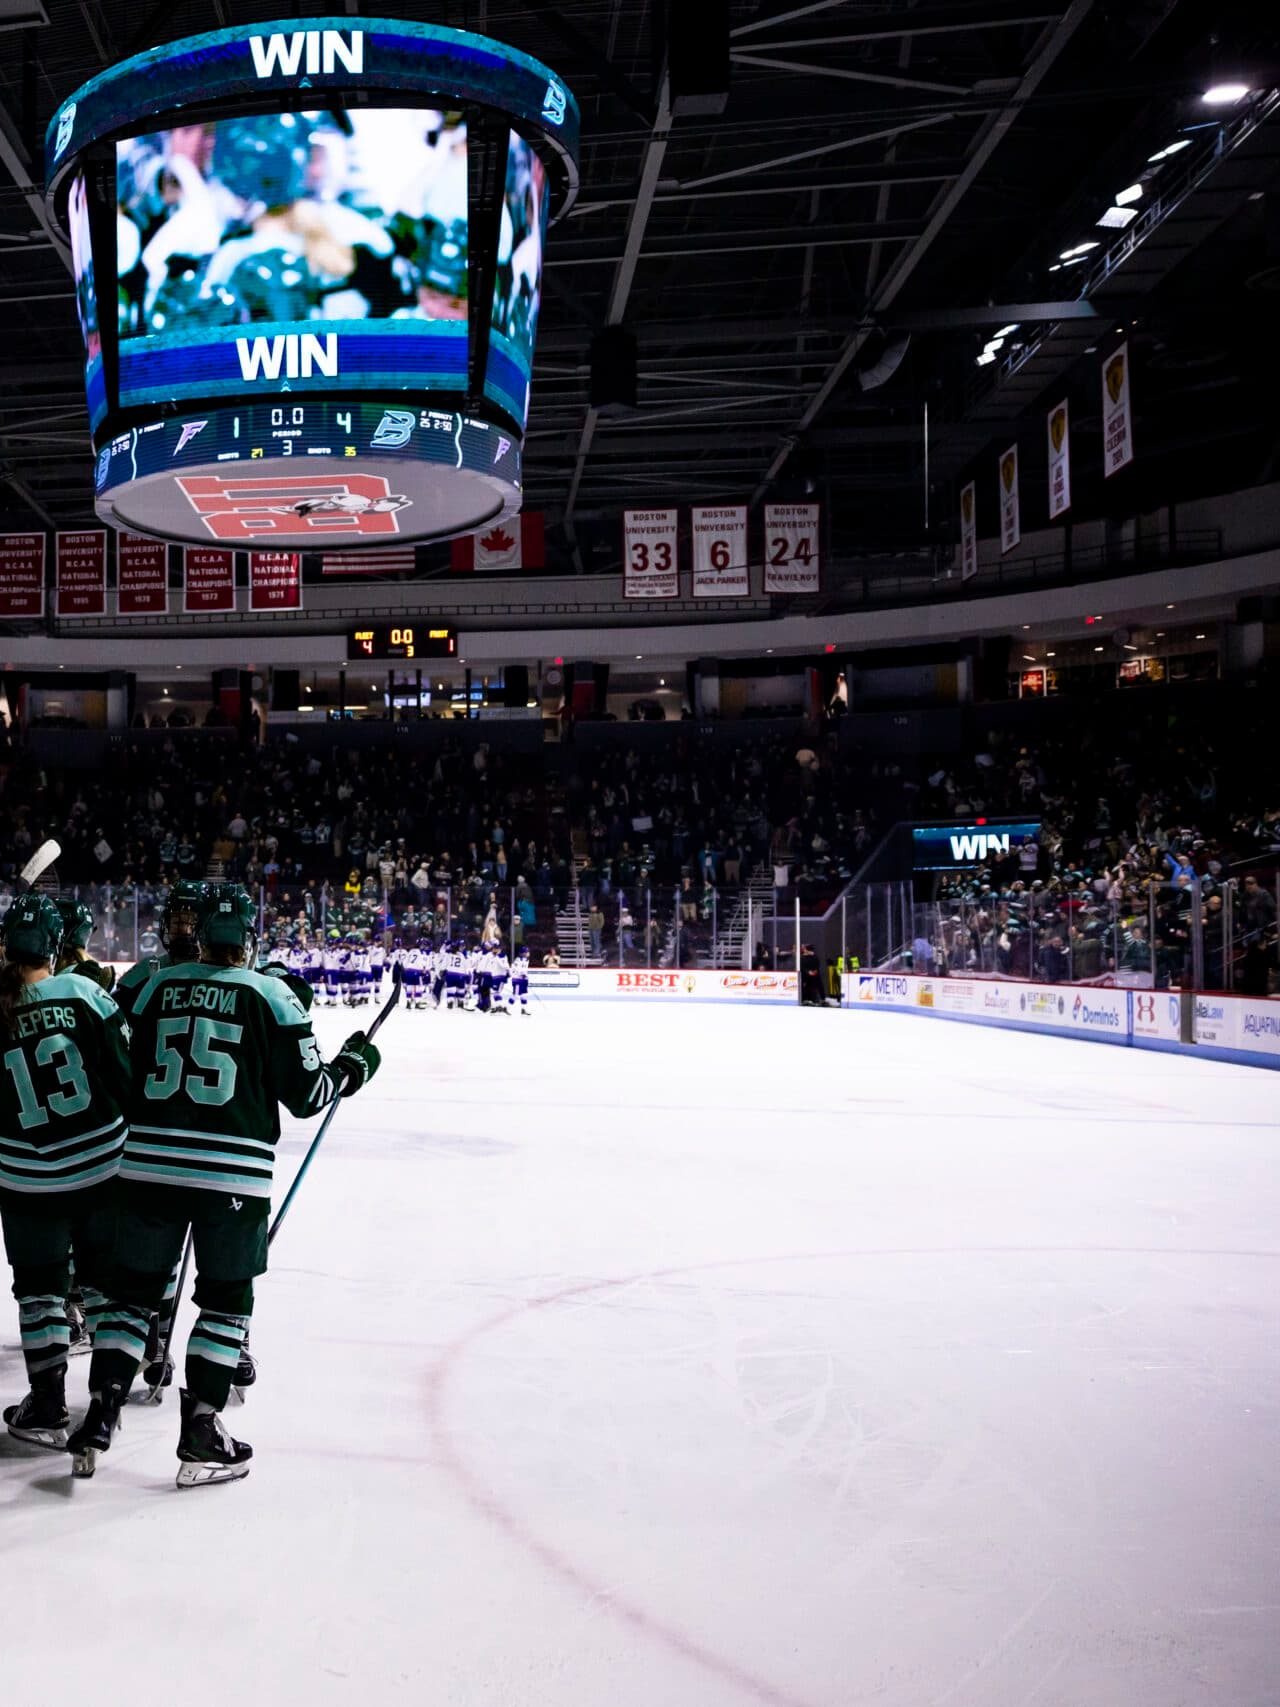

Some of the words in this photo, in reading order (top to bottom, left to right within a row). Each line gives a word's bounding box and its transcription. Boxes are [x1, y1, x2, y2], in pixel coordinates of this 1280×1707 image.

[249, 31, 364, 78] WIN
[236, 333, 338, 380] WIN
[271, 407, 303, 425] 0.0
[233, 417, 240, 438] 1
[336, 411, 351, 434] 4
[282, 440, 293, 456] 3
[633, 513, 667, 521] BOSTON
[701, 510, 736, 518] BOSTON
[774, 507, 808, 515] BOSTON
[625, 526, 676, 534] UNIVERSITY
[695, 523, 745, 532] UNIVERSITY
[767, 520, 817, 528] UNIVERSITY
[4, 537, 36, 545] BOSTON
[65, 535, 96, 543] BOSTON
[59, 547, 104, 556] UNIVERSITY
[120, 545, 166, 553] UNIVERSITY
[771, 538, 811, 566] 24
[632, 543, 672, 571] 33
[710, 541, 730, 571] 6
[61, 572, 99, 580] NATIONAL
[122, 570, 161, 578] NATIONAL
[188, 568, 228, 576] NATIONAL
[253, 566, 296, 574] NATIONAL
[0, 574, 38, 582] NATIONAL
[187, 579, 232, 588] CHAMPIONS
[253, 578, 298, 586] CHAMPIONS
[696, 576, 715, 584] JACK
[717, 575, 747, 585] PARKER
[59, 584, 104, 592] CHAMPIONS
[120, 582, 165, 590] CHAMPIONS
[362, 641, 372, 653] 4
[407, 645, 414, 657] 3
[449, 638, 454, 652] 1
[949, 833, 1010, 860] WIN
[616, 973, 680, 987] BEST
[876, 977, 908, 995] METRO
[161, 984, 239, 1016] PEJŠOVÁ
[1082, 1004, 1120, 1026] Domino's
[16, 1006, 77, 1039] EPERS
[298, 1035, 321, 1072] 5
[144, 1016, 244, 1106] 55
[3, 1033, 92, 1130] 13
